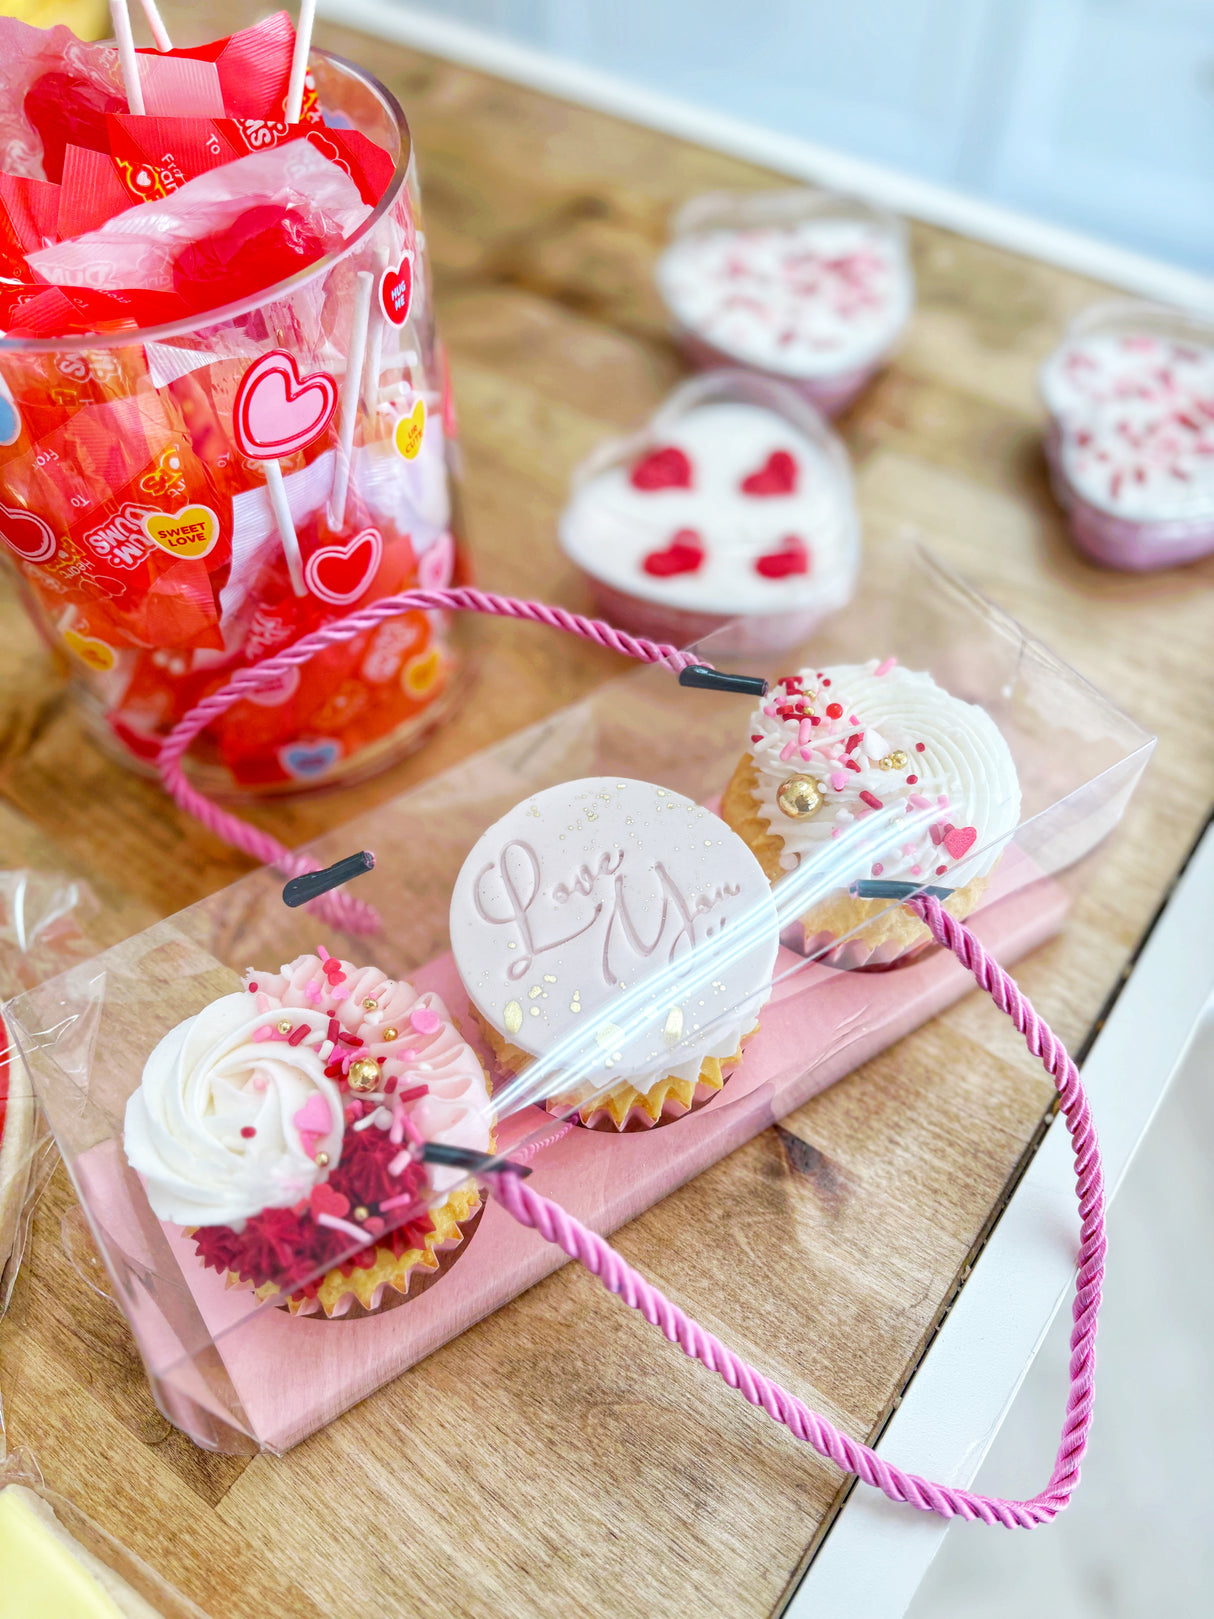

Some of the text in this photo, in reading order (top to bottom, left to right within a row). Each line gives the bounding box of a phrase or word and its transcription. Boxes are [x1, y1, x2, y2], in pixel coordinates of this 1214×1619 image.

[205, 133, 221, 155] To
[391, 280, 406, 301] HUG
[73, 297, 89, 309] To
[395, 294, 405, 312] ME
[408, 424, 418, 440] UR
[405, 429, 423, 454] CUTE
[217, 452, 230, 468] To
[70, 494, 91, 508] To
[157, 521, 206, 539] SWEET
[168, 532, 207, 548] LOVE
[61, 557, 96, 580] Heart
[473, 838, 742, 986] Love You
